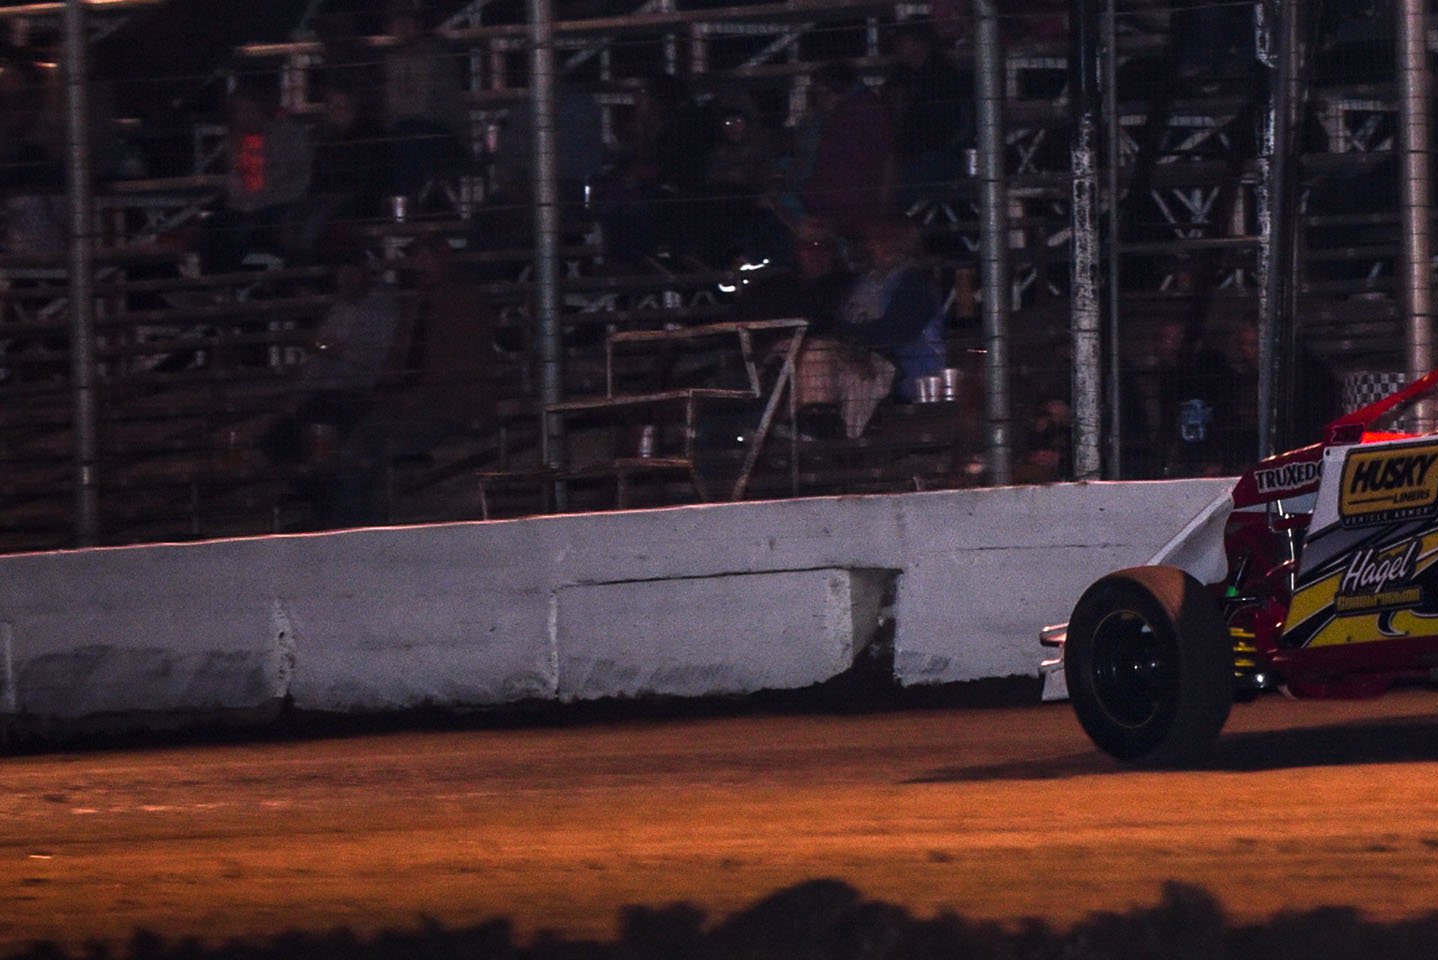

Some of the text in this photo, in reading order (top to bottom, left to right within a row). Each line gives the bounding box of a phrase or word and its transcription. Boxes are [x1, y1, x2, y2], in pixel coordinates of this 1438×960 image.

[1351, 453, 1438, 494] HUSKY
[1393, 489, 1430, 504] LINERS
[1342, 540, 1417, 593] Hagel
